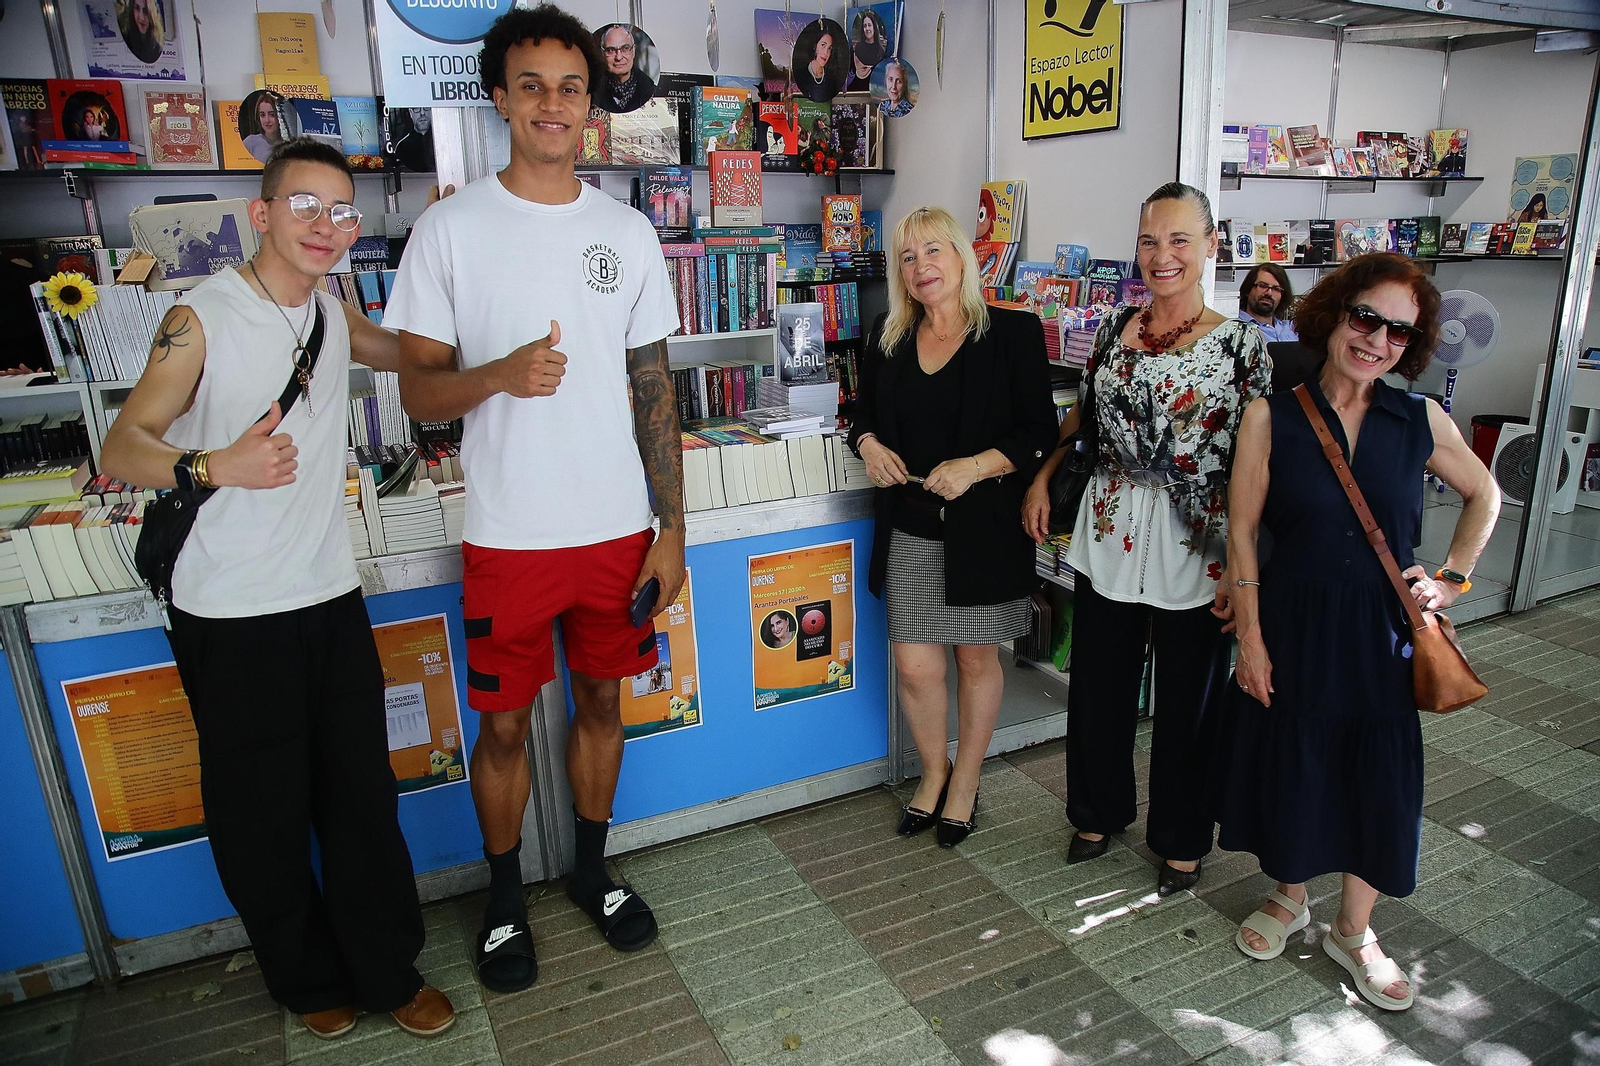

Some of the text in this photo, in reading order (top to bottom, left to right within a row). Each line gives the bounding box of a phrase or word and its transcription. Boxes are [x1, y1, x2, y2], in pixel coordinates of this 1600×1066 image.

[402, 55, 427, 76] EN
[1030, 44, 1114, 75] Espazo Lector
[1, 84, 43, 93] EMORIAS
[431, 81, 491, 101] LIBROS
[1029, 66, 1114, 123] Nobel
[713, 94, 740, 102] GALIZA
[5, 101, 46, 109] ABREGO
[712, 102, 741, 110] NATURA
[722, 158, 754, 169] REDES
[50, 241, 91, 252] PETER PAN
[582, 243, 623, 265] BASKETBALL
[600, 257, 609, 279] B
[585, 279, 620, 295] ACADEMY
[795, 317, 811, 331] 25
[795, 336, 812, 349] DE
[784, 354, 824, 369] ABRIL
[752, 574, 775, 587] OURENSE
[828, 572, 846, 584] -10%
[753, 591, 778, 600] Mércores
[754, 594, 809, 609] Arantza Portabales
[664, 603, 685, 615] -10%
[417, 651, 441, 664] -10%
[74, 696, 95, 704] FEIRA
[394, 693, 419, 703] PORTAS
[76, 701, 111, 718] OURENSE
[386, 700, 420, 710] CONDENADAS
[604, 889, 625, 907] NIKE
[489, 924, 515, 943] NIKE
